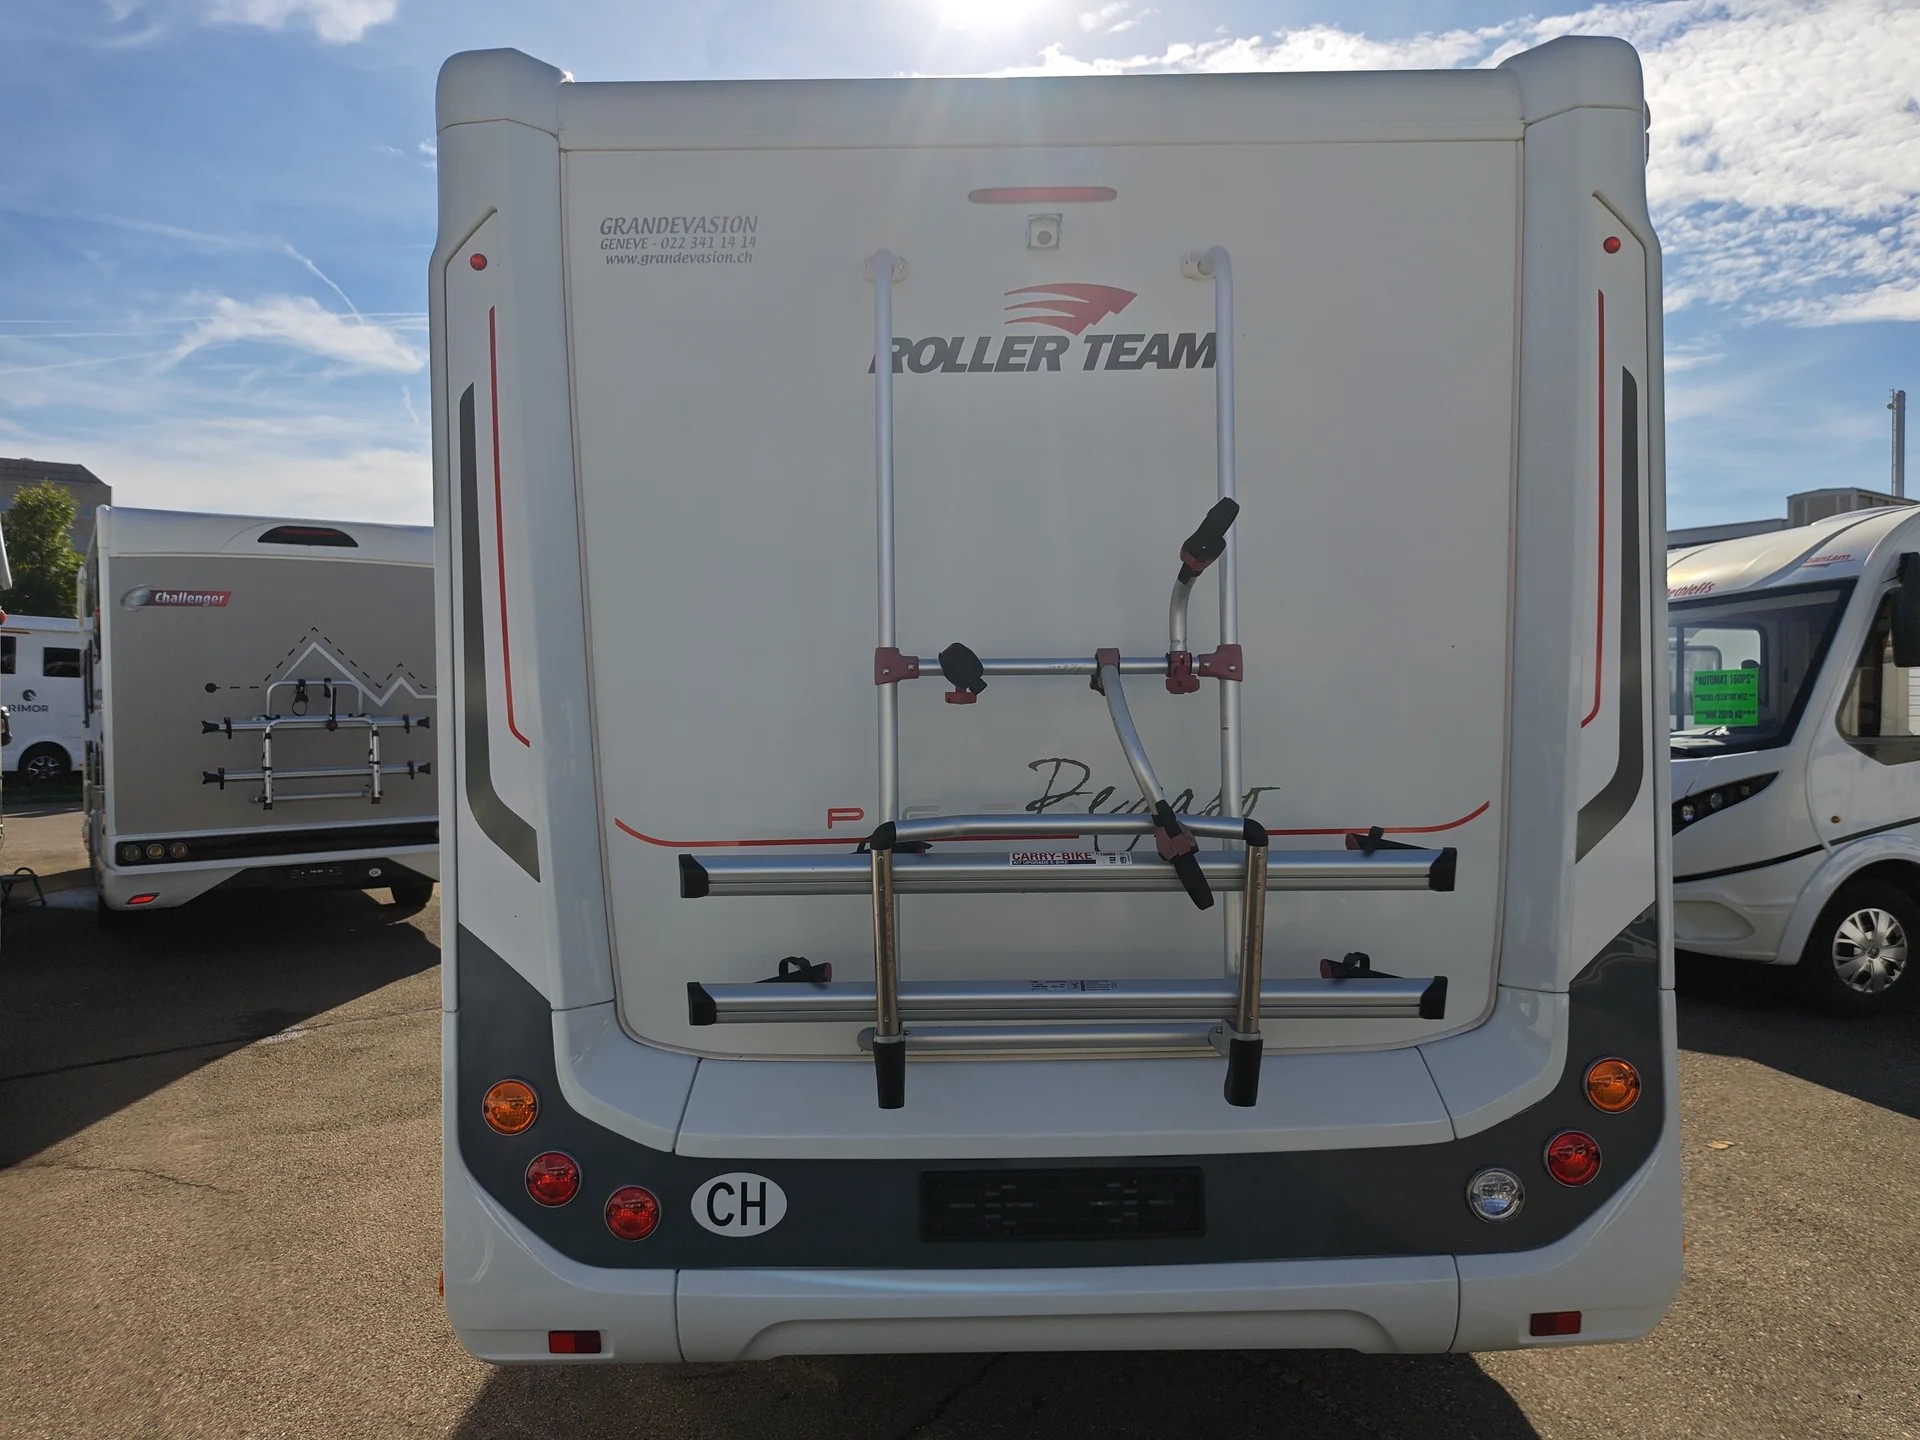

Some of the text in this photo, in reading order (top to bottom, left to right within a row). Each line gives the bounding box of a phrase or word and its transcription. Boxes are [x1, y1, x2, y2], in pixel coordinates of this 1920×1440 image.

[600, 216, 758, 235] GRANDEVASION
[600, 237, 648, 250] GENEVE
[660, 237, 686, 249] 022
[690, 236, 714, 249] 341
[721, 236, 735, 248] 14
[740, 236, 757, 248] 14
[605, 251, 752, 266] www.grandevasion.ch
[868, 332, 1217, 374] ROLLER TEAM
[155, 591, 225, 606] Challenger
[8, 704, 49, 712] RIMOR
[1011, 852, 1093, 861] CARRY-BIKE
[706, 1181, 767, 1227] CH
